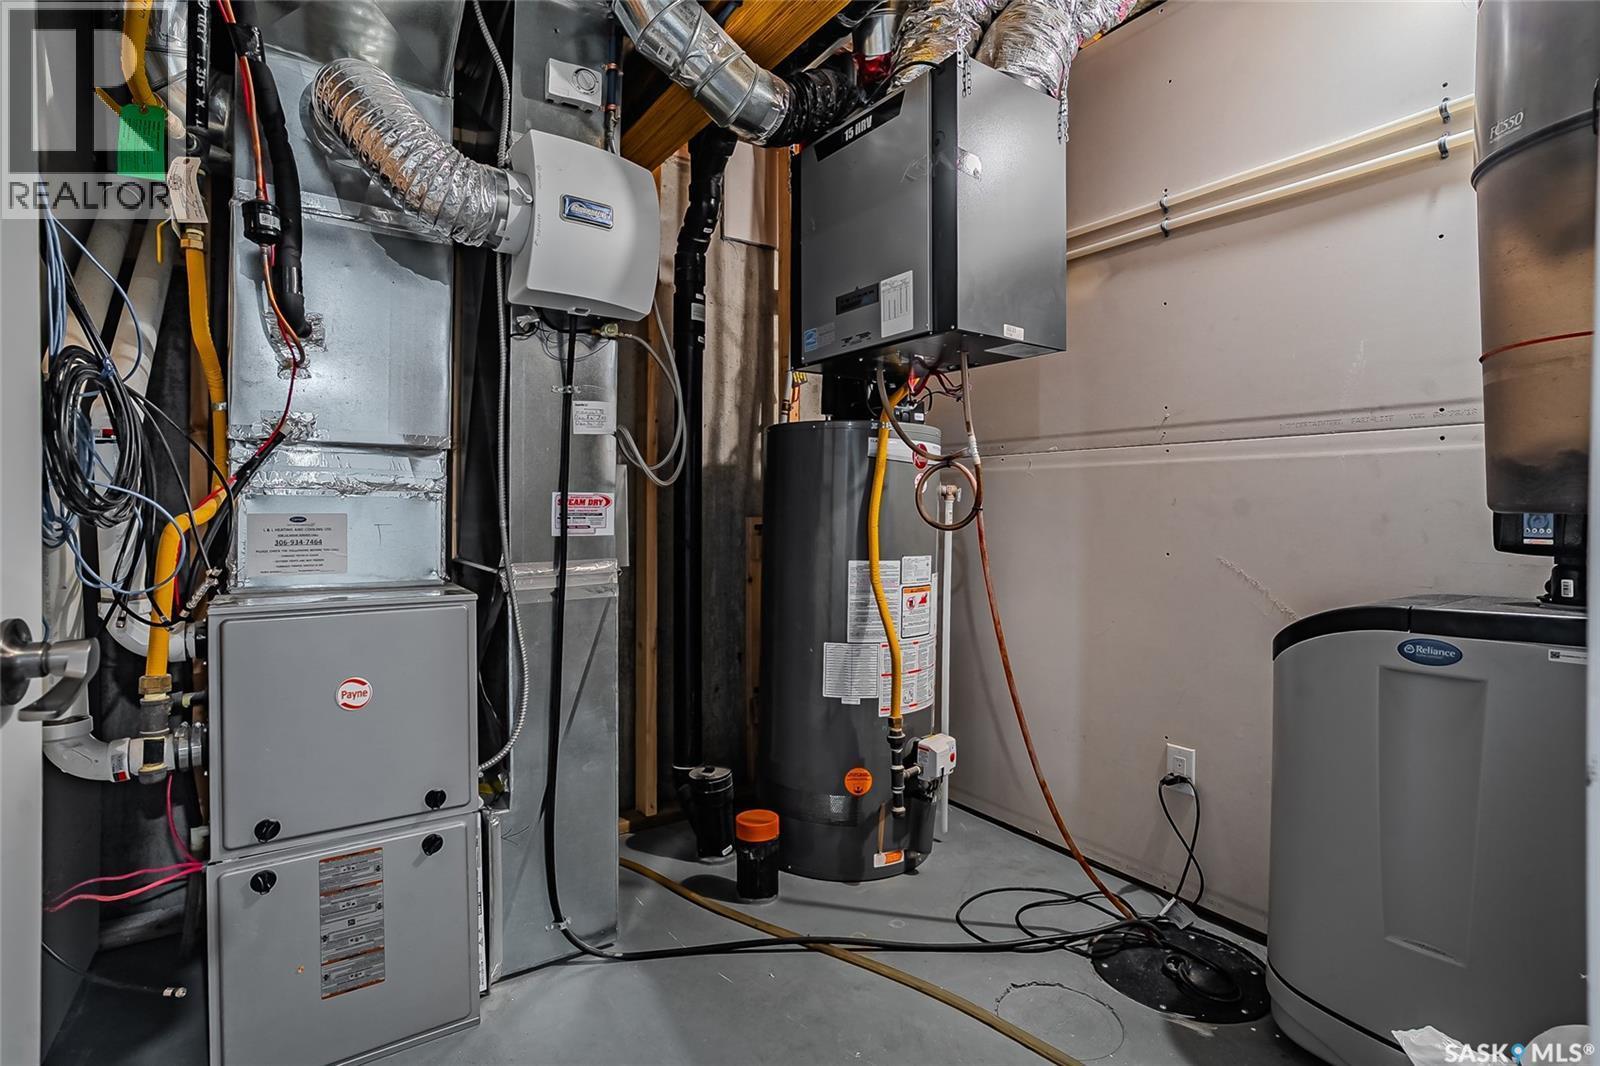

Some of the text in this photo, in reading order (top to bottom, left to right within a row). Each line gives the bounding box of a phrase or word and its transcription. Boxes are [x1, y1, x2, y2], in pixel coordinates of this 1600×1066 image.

[844, 114, 873, 141] 15 HRV
[1489, 111, 1524, 139] FC550
[588, 498, 604, 506] DRY
[274, 539, 323, 547] 306-934-7464
[1415, 645, 1456, 657] Reliance
[341, 689, 368, 700] Payne
